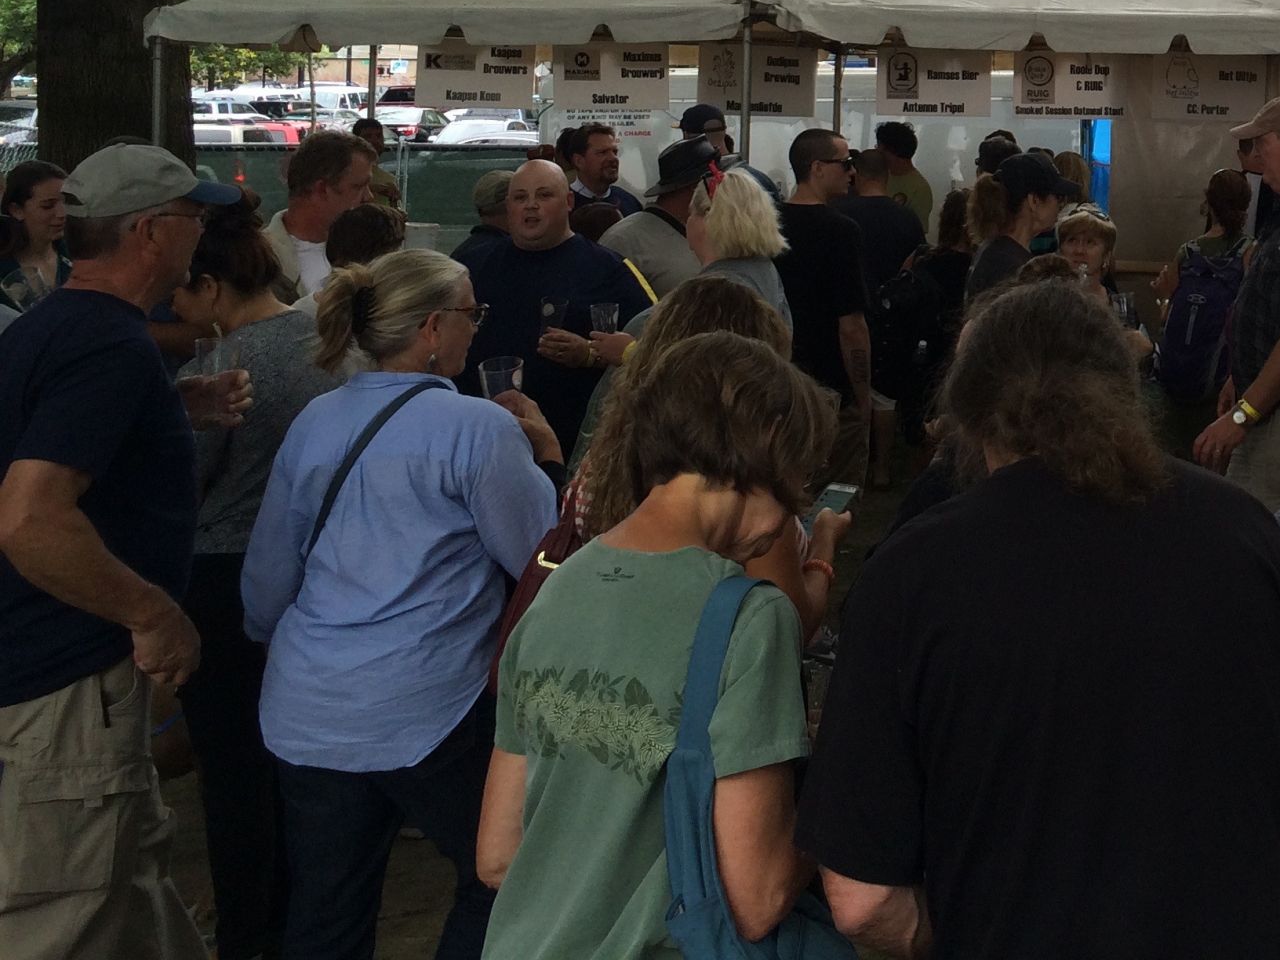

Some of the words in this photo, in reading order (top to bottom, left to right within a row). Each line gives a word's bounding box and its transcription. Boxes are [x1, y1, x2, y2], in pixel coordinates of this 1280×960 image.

[491, 47, 522, 59] Kaapse
[623, 52, 662, 62] Maximus
[483, 64, 527, 75] Brouwers
[927, 70, 960, 80] Ramses
[962, 70, 980, 80] Bier
[1095, 64, 1109, 76] Dop
[764, 72, 800, 84] Brewing
[446, 89, 477, 102] Kaapse
[592, 93, 629, 104] Salvator
[1027, 89, 1049, 98] RUIG
[903, 102, 938, 112] Antenne
[940, 102, 965, 114] Tripel
[1015, 106, 1043, 115] Smoked
[1045, 106, 1072, 115] Session
[1074, 106, 1102, 115] Oatmeal
[1104, 107, 1124, 116] Stout
[1201, 104, 1229, 115] Porter
